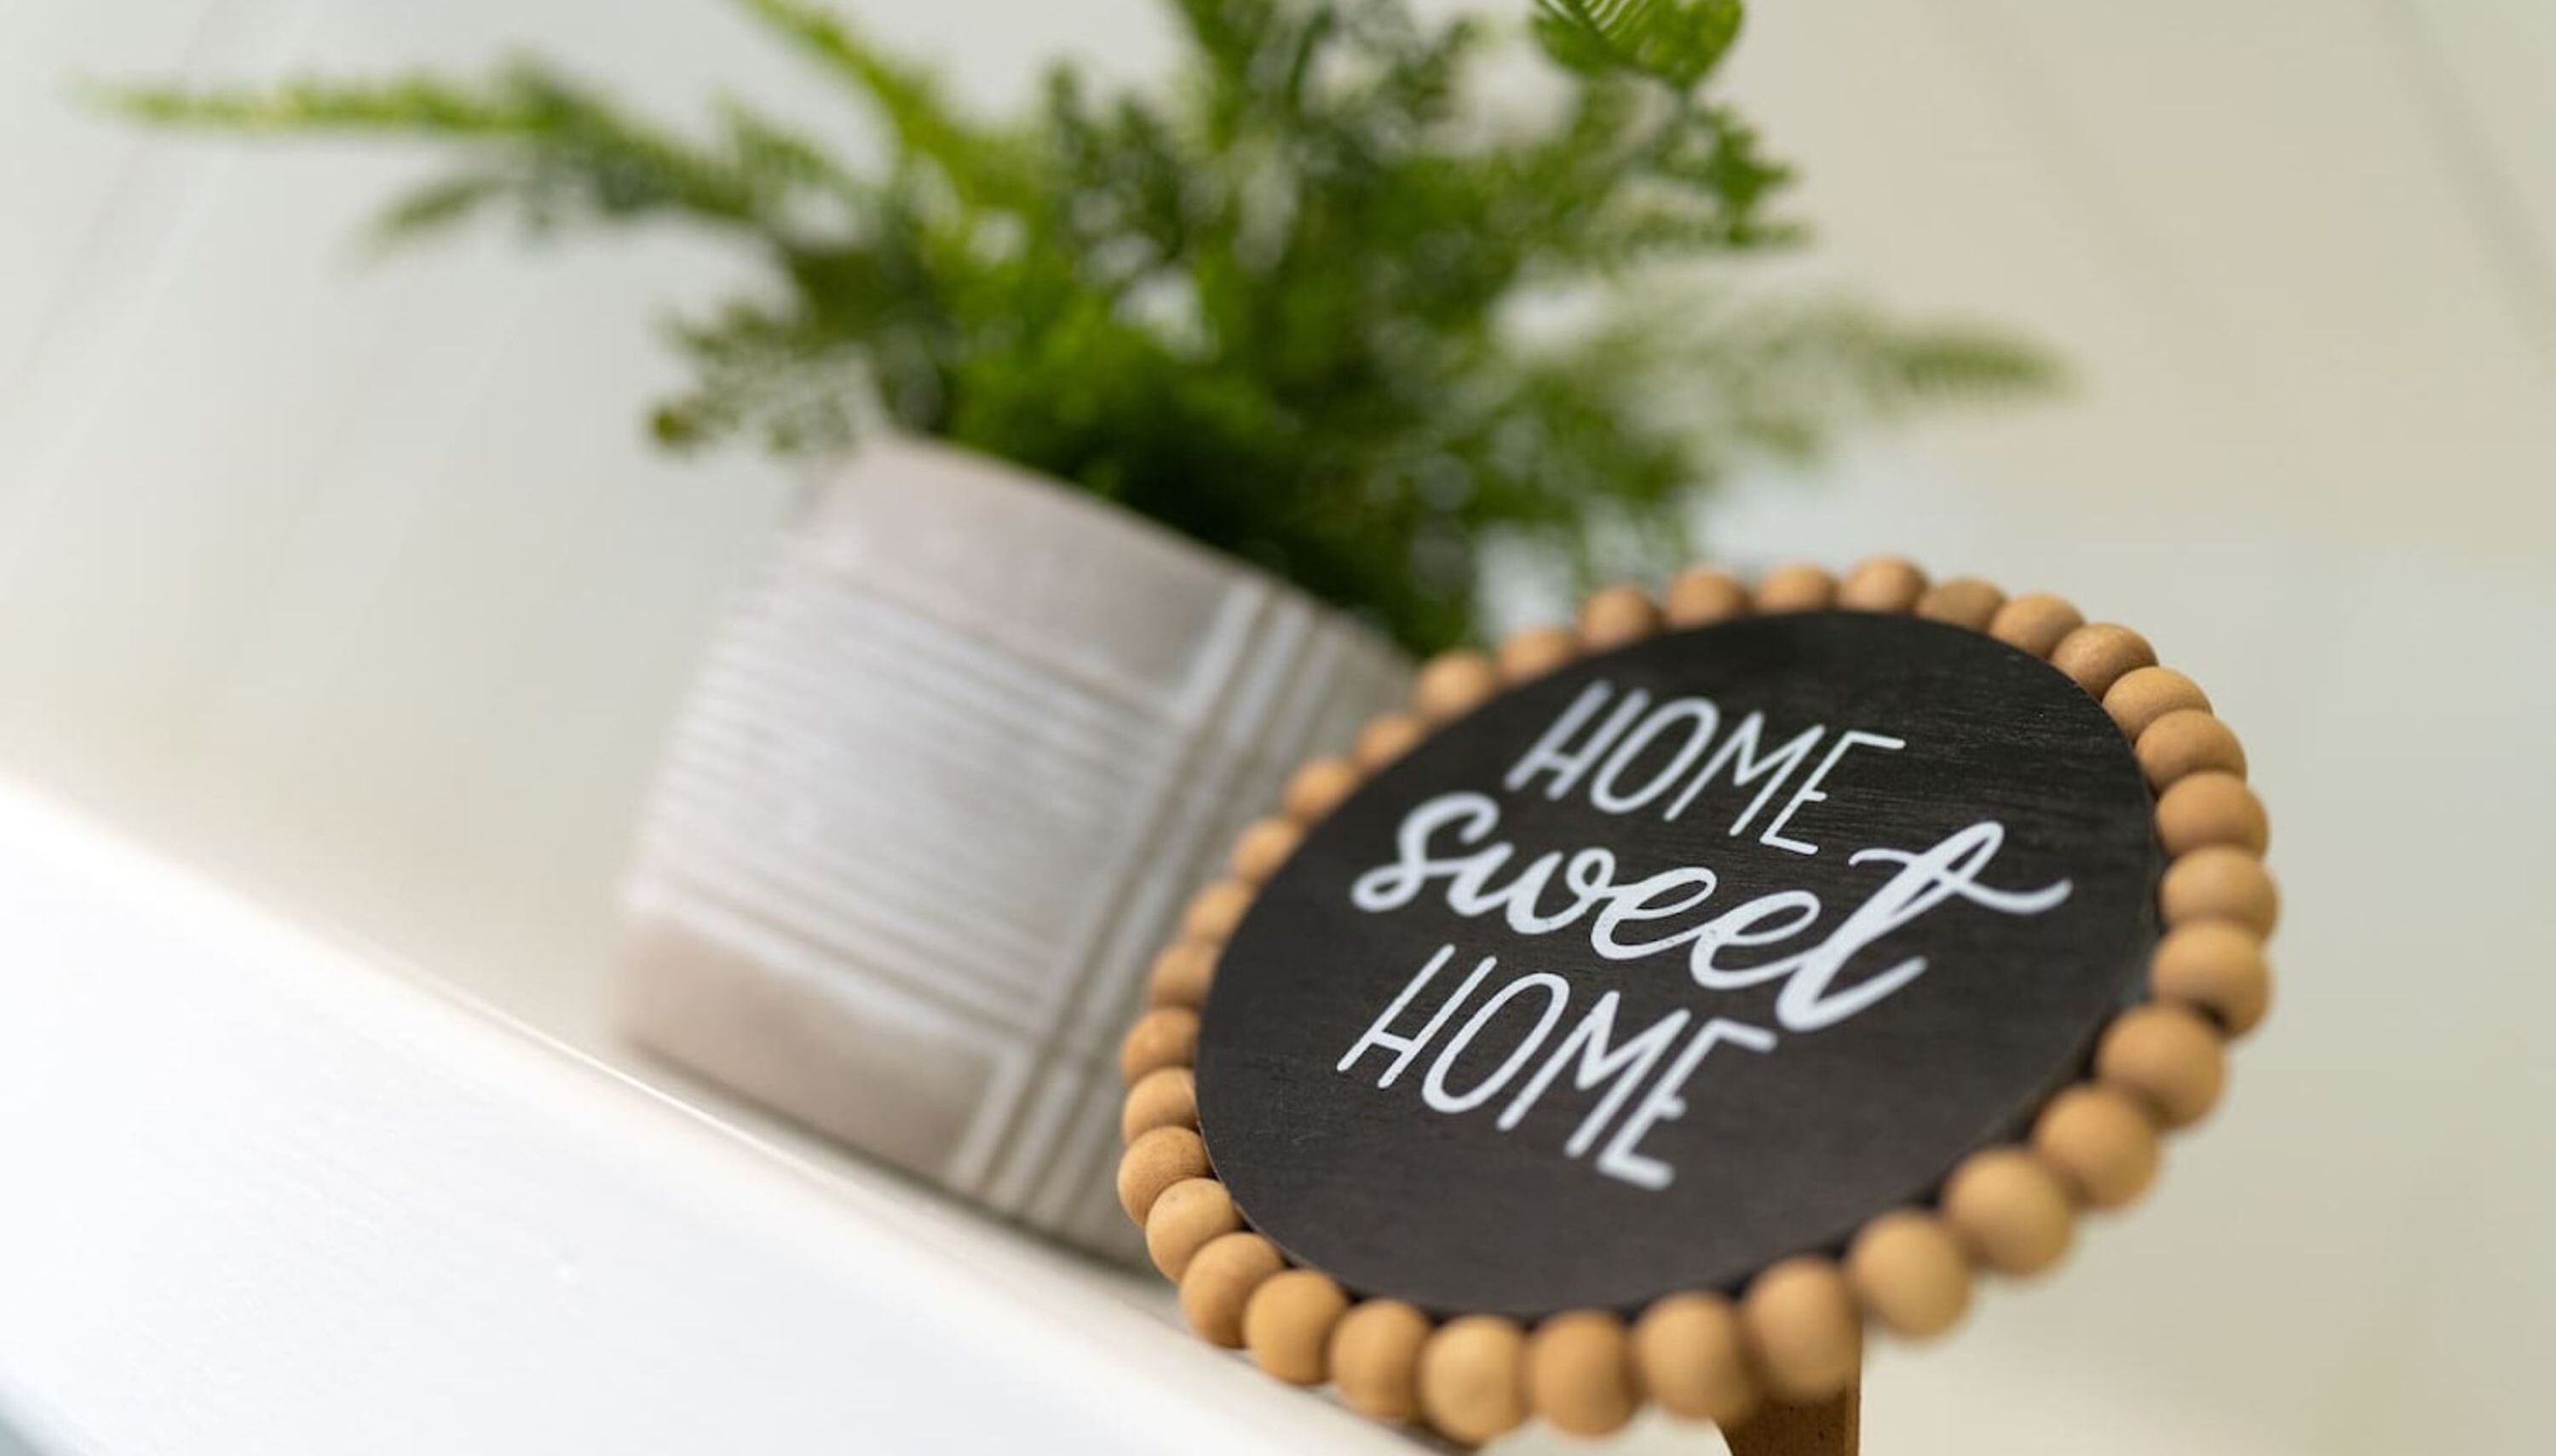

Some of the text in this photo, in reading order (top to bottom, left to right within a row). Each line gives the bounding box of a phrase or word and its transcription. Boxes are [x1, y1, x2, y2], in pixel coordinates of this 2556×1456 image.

[1506, 679, 1907, 855] HOME
[1351, 793, 2071, 1032] sweet
[1335, 943, 1776, 1189] HOME
